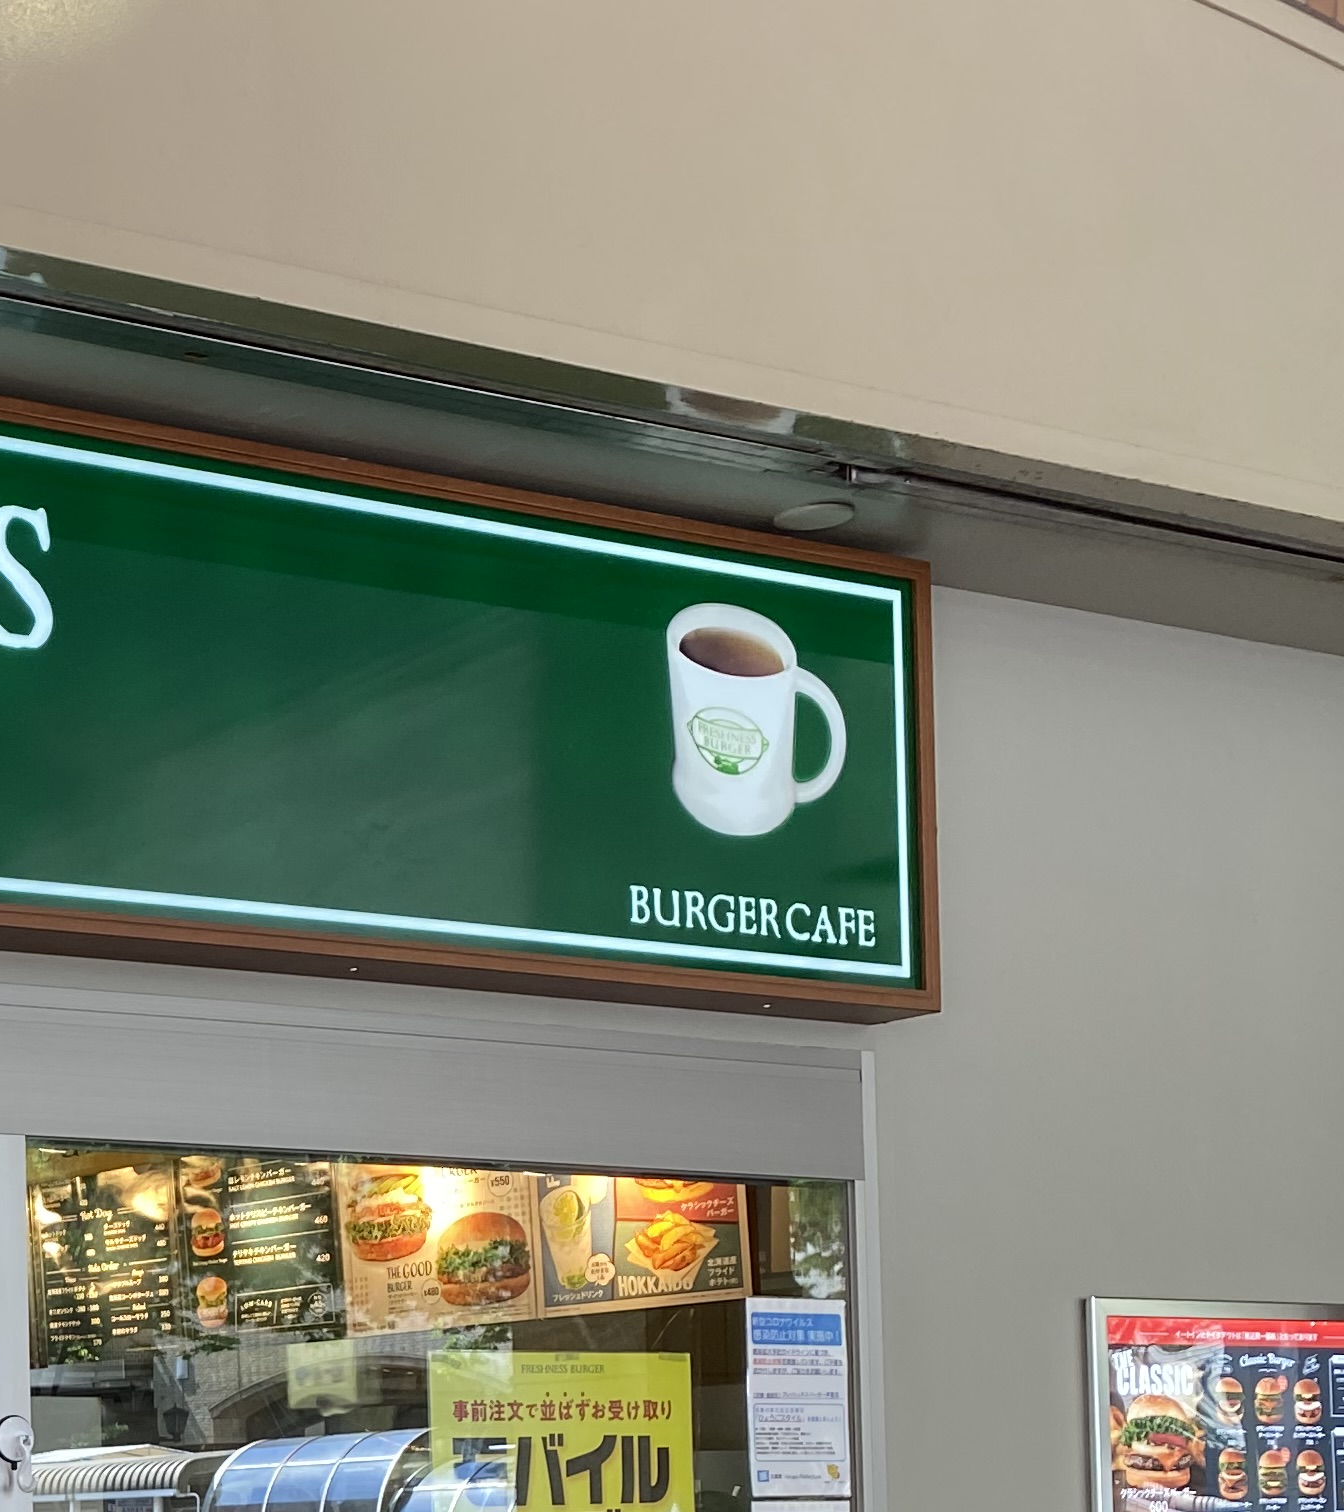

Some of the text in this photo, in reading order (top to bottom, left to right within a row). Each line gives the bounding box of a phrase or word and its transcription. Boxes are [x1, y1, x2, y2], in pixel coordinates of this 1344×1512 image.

[698, 720, 756, 744] FRESHNESS
[704, 736, 751, 755] BURGER
[490, 1175, 510, 1187] ¥550
[386, 1261, 432, 1280] THE GOOD
[387, 1280, 412, 1293] BURGER
[618, 1275, 695, 1296] HOKKAIDO
[521, 1364, 605, 1374] FRESHNESS BURGER
[1116, 1363, 1194, 1396] CLASSIC
[453, 1399, 672, 1422] 事前注文で並ばずお受け取り
[452, 1433, 669, 1505] モバイル
